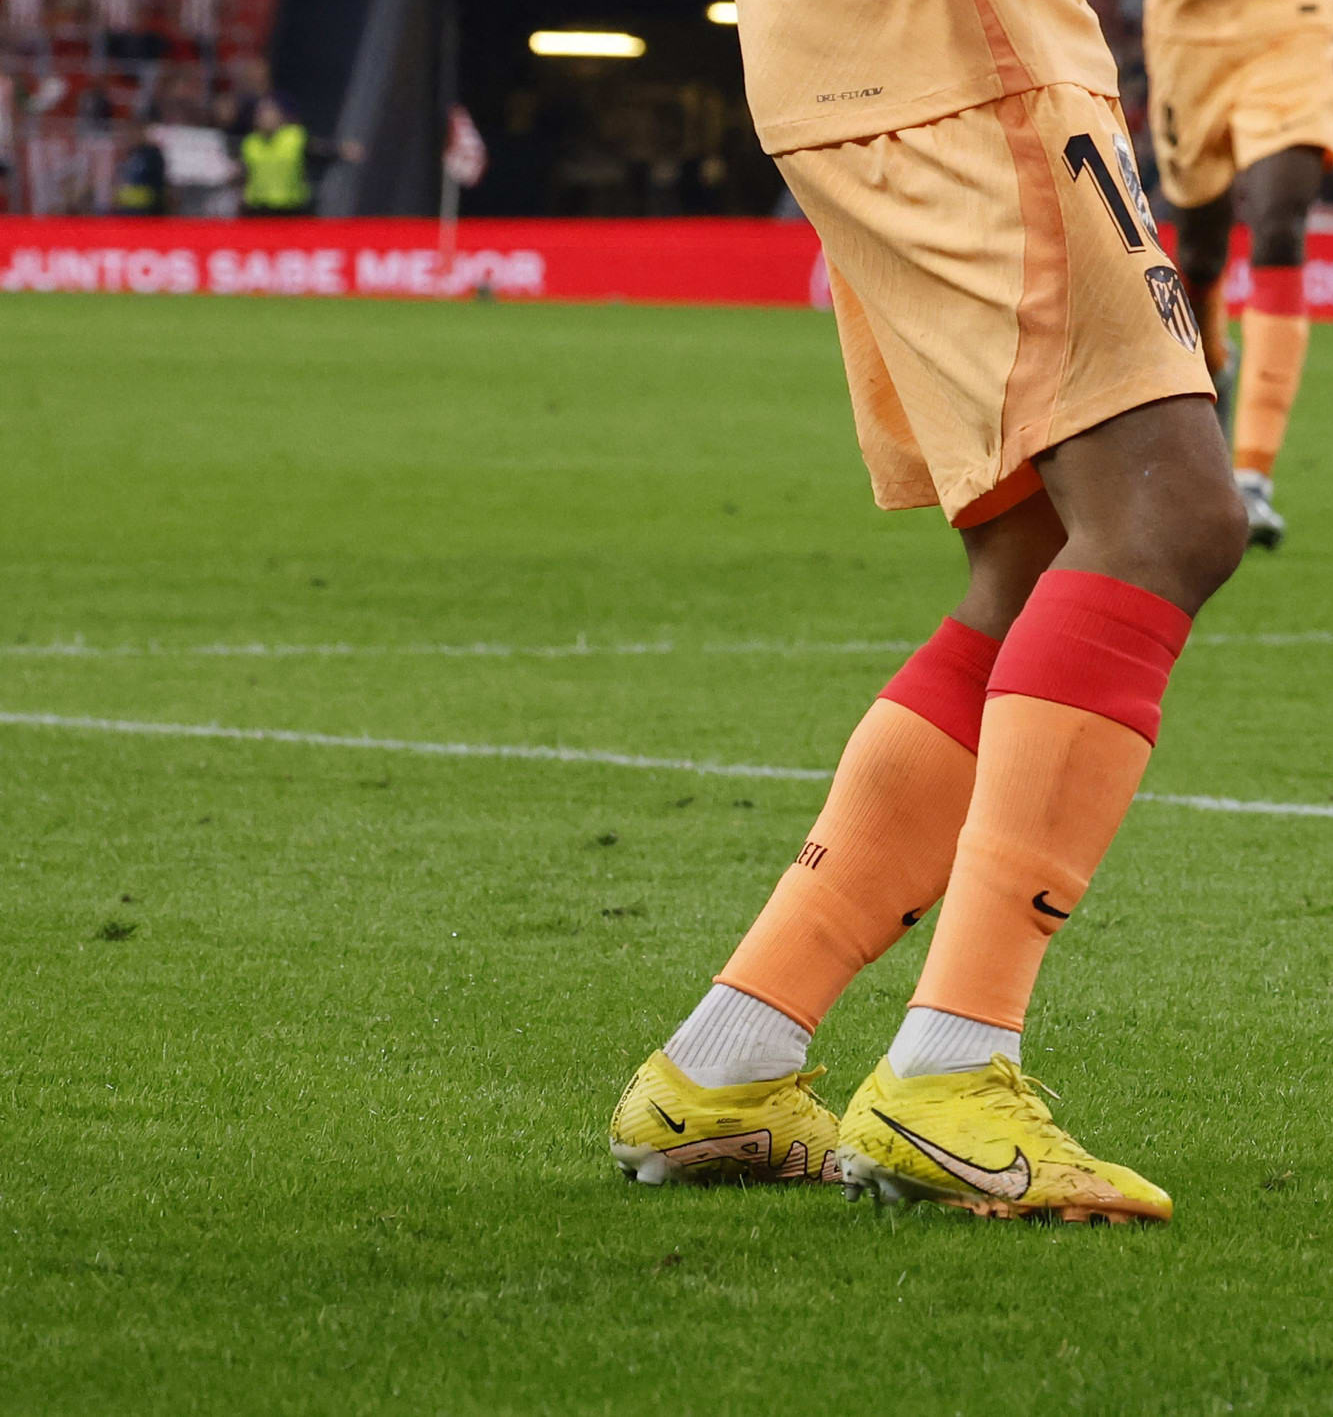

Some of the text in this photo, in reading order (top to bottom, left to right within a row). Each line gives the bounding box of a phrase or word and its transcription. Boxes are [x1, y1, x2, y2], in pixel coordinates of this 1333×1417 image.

[2, 249, 546, 295] JUNTOS SABE MEJOR
